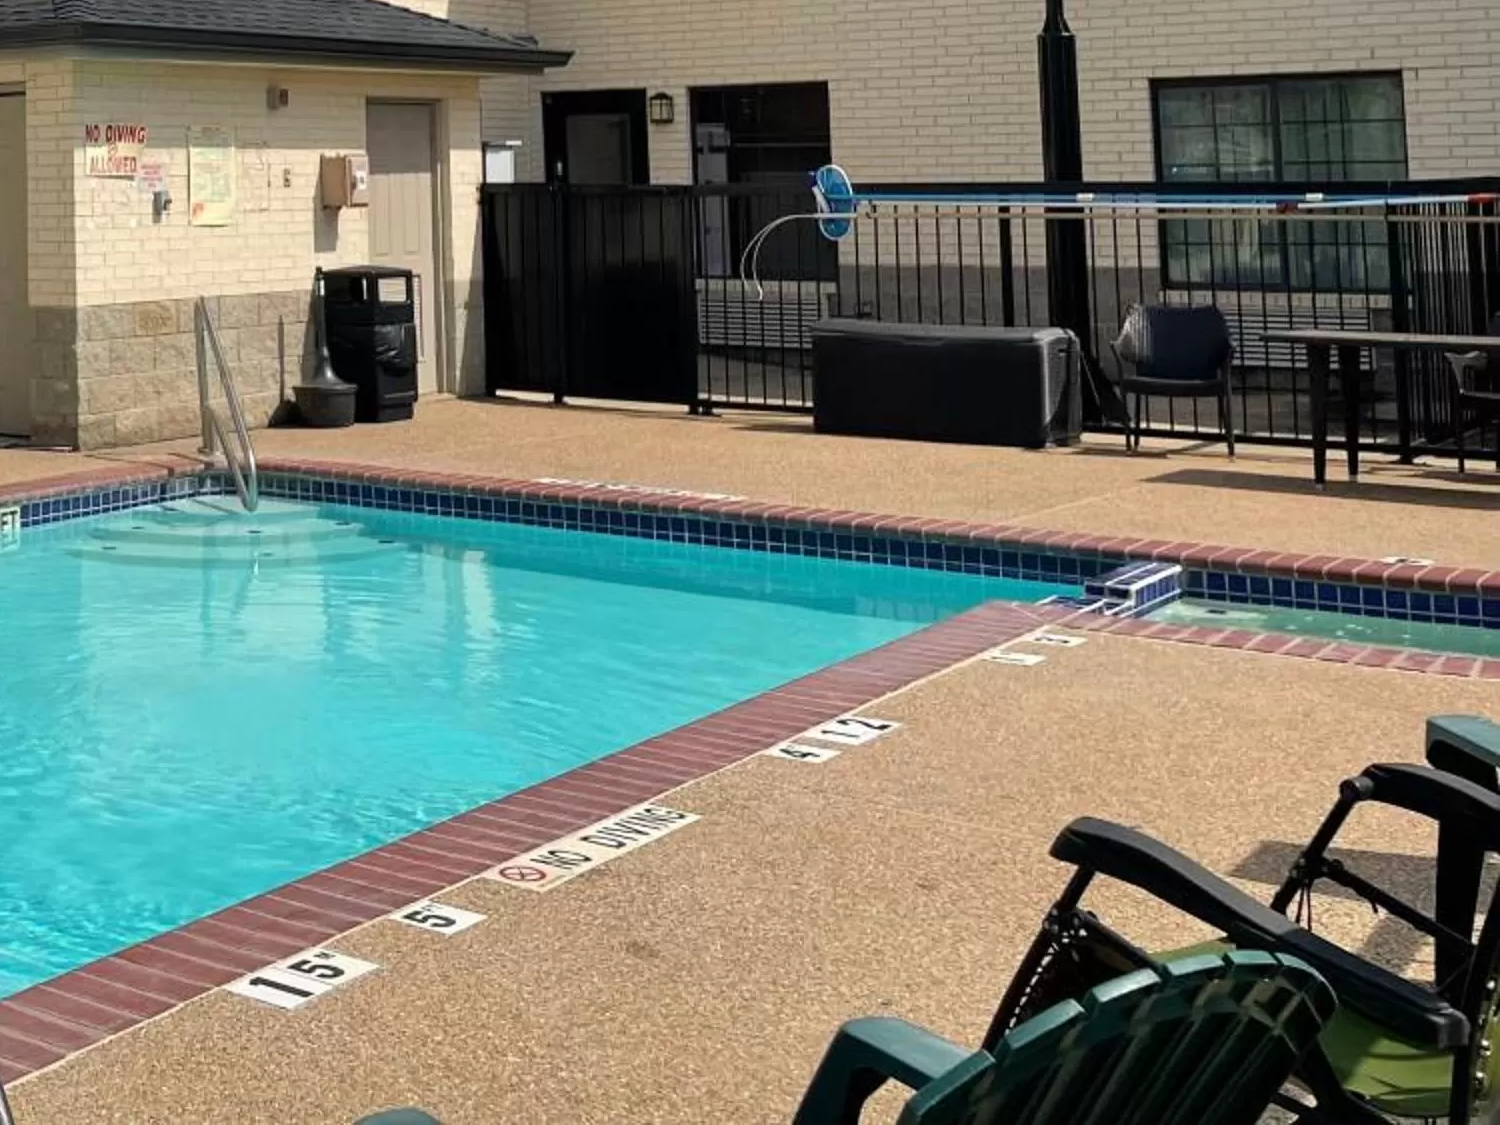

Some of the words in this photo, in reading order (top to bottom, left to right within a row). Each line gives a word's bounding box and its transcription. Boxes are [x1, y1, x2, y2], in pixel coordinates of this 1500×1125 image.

[85, 124, 100, 142] NO
[105, 125, 146, 144] DIVING
[90, 155, 137, 174] ALLOWED
[0, 510, 18, 533] FT
[529, 849, 592, 870] NO
[579, 803, 686, 849] DIVING
